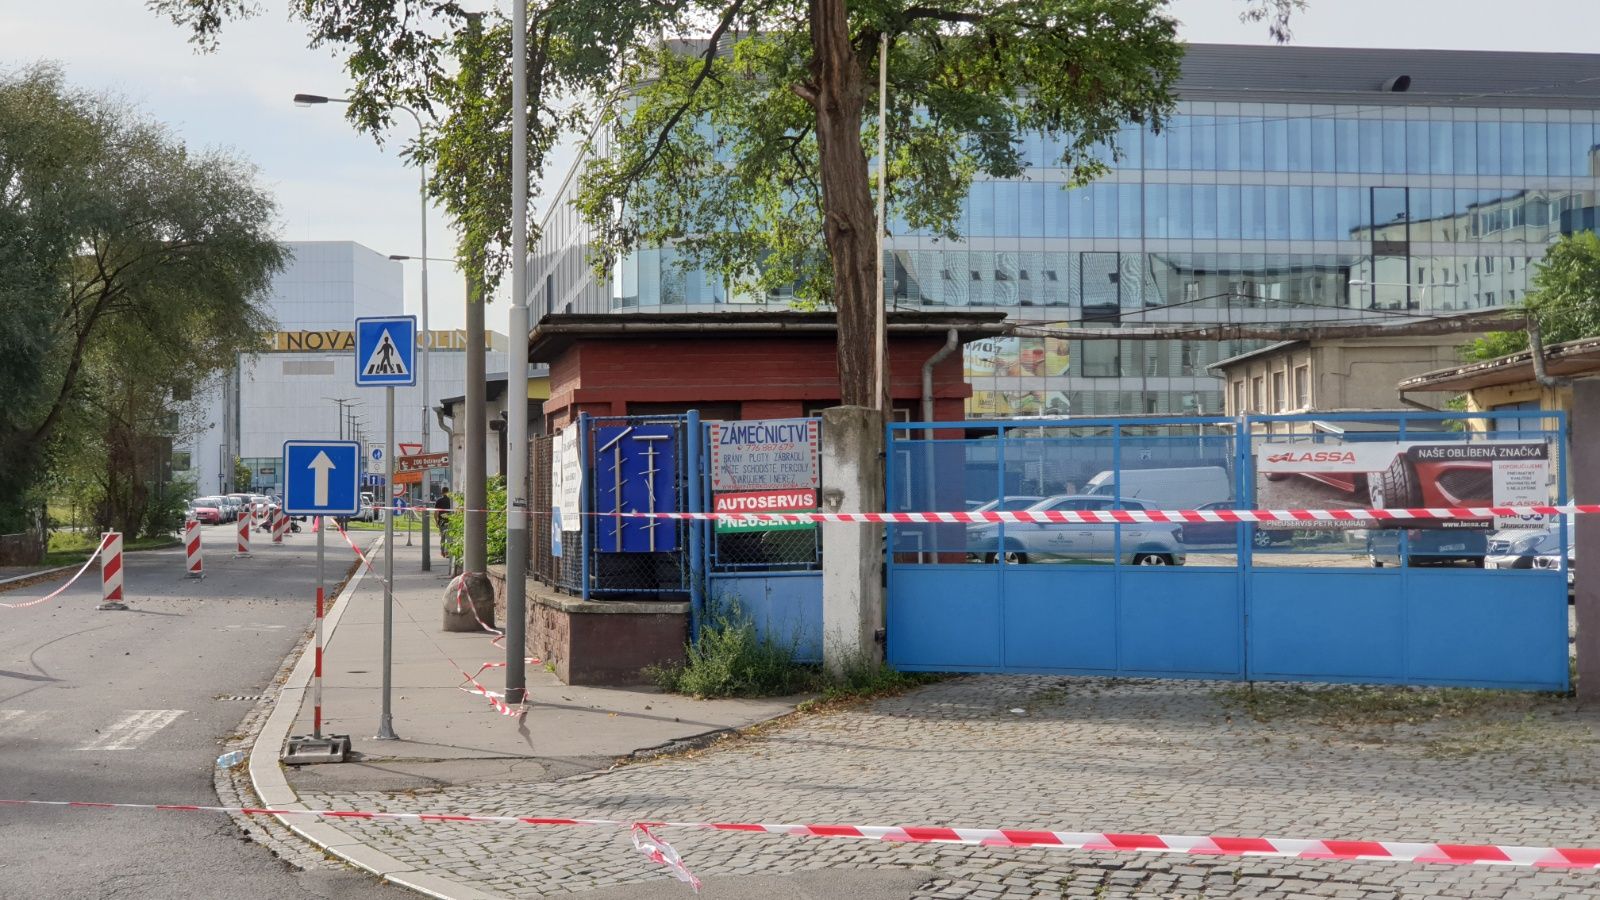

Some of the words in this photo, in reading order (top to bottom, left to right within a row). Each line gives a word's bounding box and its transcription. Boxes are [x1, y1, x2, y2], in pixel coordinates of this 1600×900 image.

[720, 422, 808, 444] ZÁMEČNICTVÍ
[748, 453, 769, 462] PLOTY
[1287, 451, 1355, 462] LASSA
[1418, 448, 1445, 459] NAŠE
[1447, 446, 1497, 458] OBLÍBENÁ
[1499, 446, 1542, 457] ZNAČKA
[717, 493, 814, 510] AUTOSERVIS
[1313, 519, 1333, 527] PETR
[1442, 520, 1489, 528] www.lassa.cz
